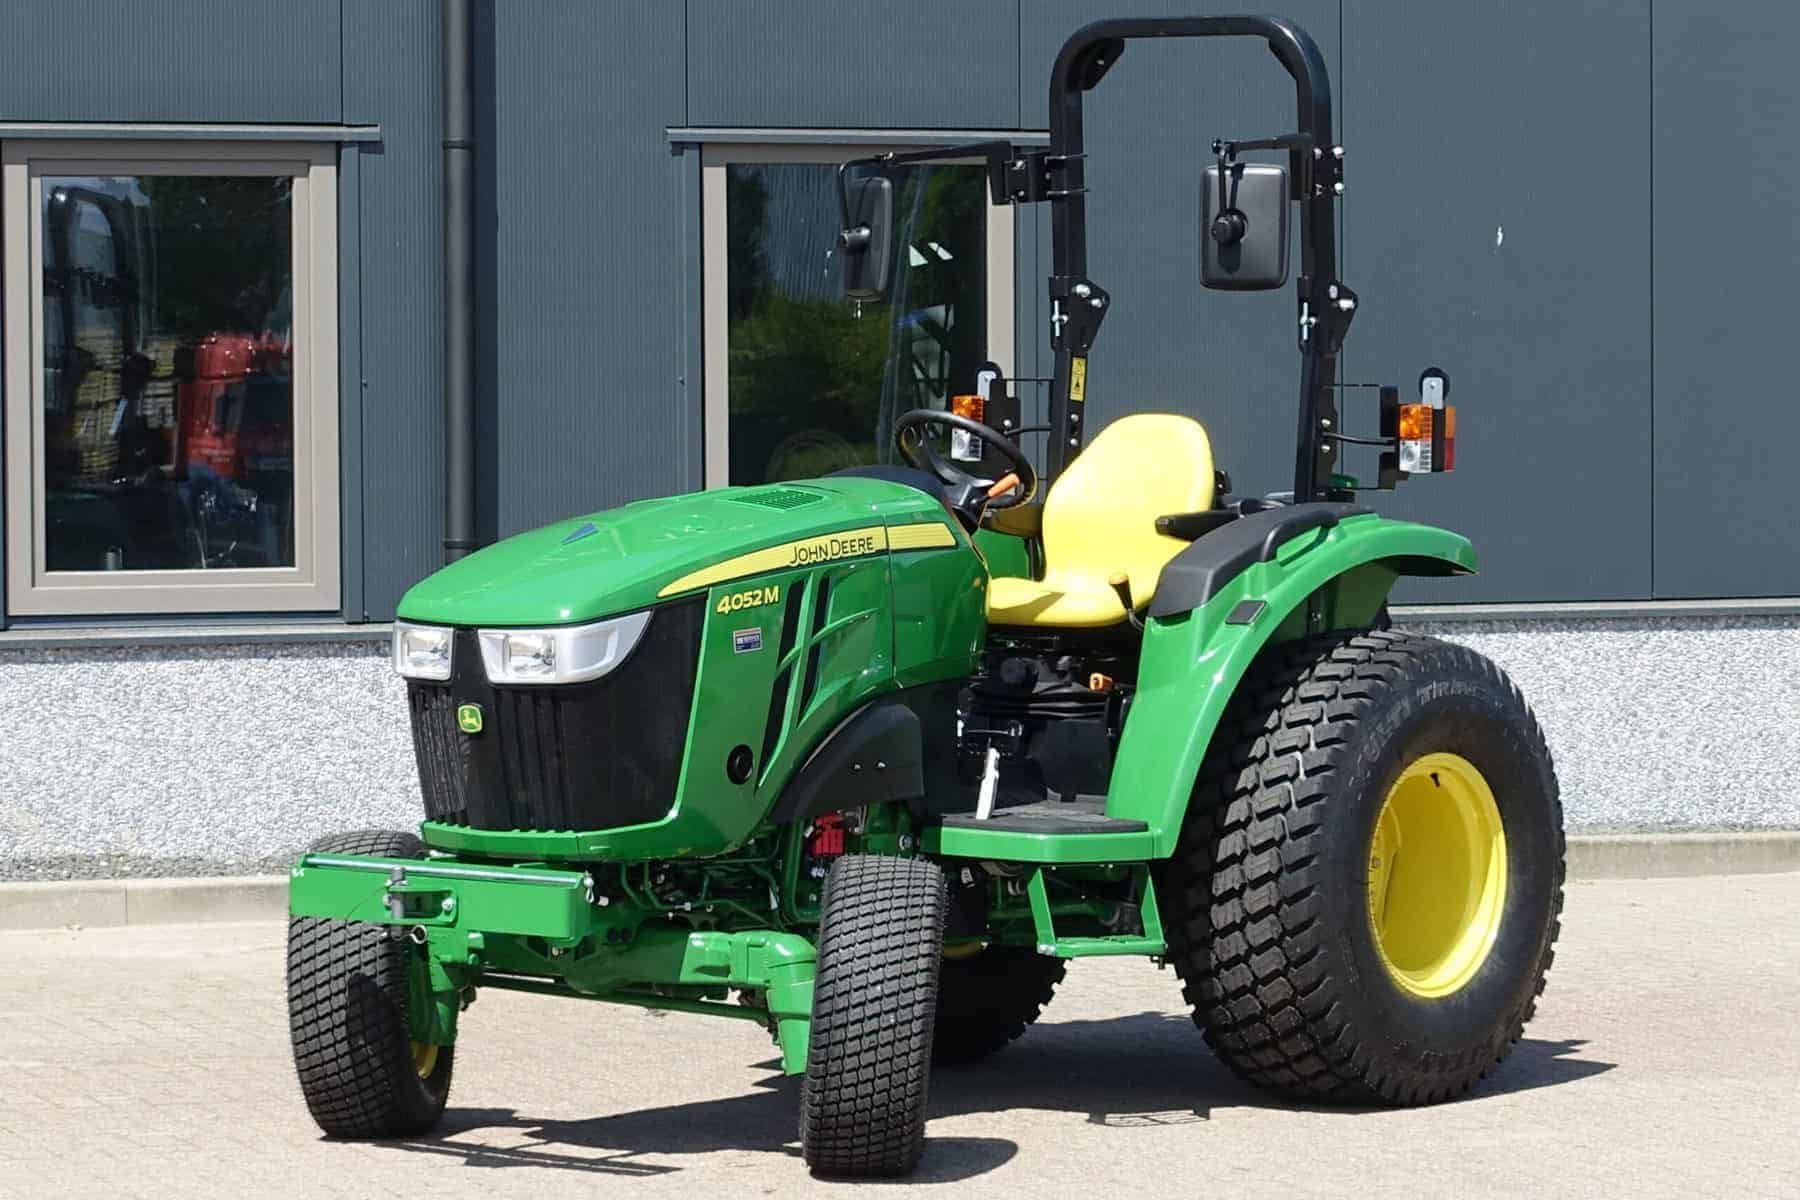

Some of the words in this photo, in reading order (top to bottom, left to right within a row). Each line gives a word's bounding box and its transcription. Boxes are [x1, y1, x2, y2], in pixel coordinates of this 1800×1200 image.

[790, 544, 828, 564] JOHN
[830, 537, 874, 556] DEERE
[716, 585, 779, 614] 4052M
